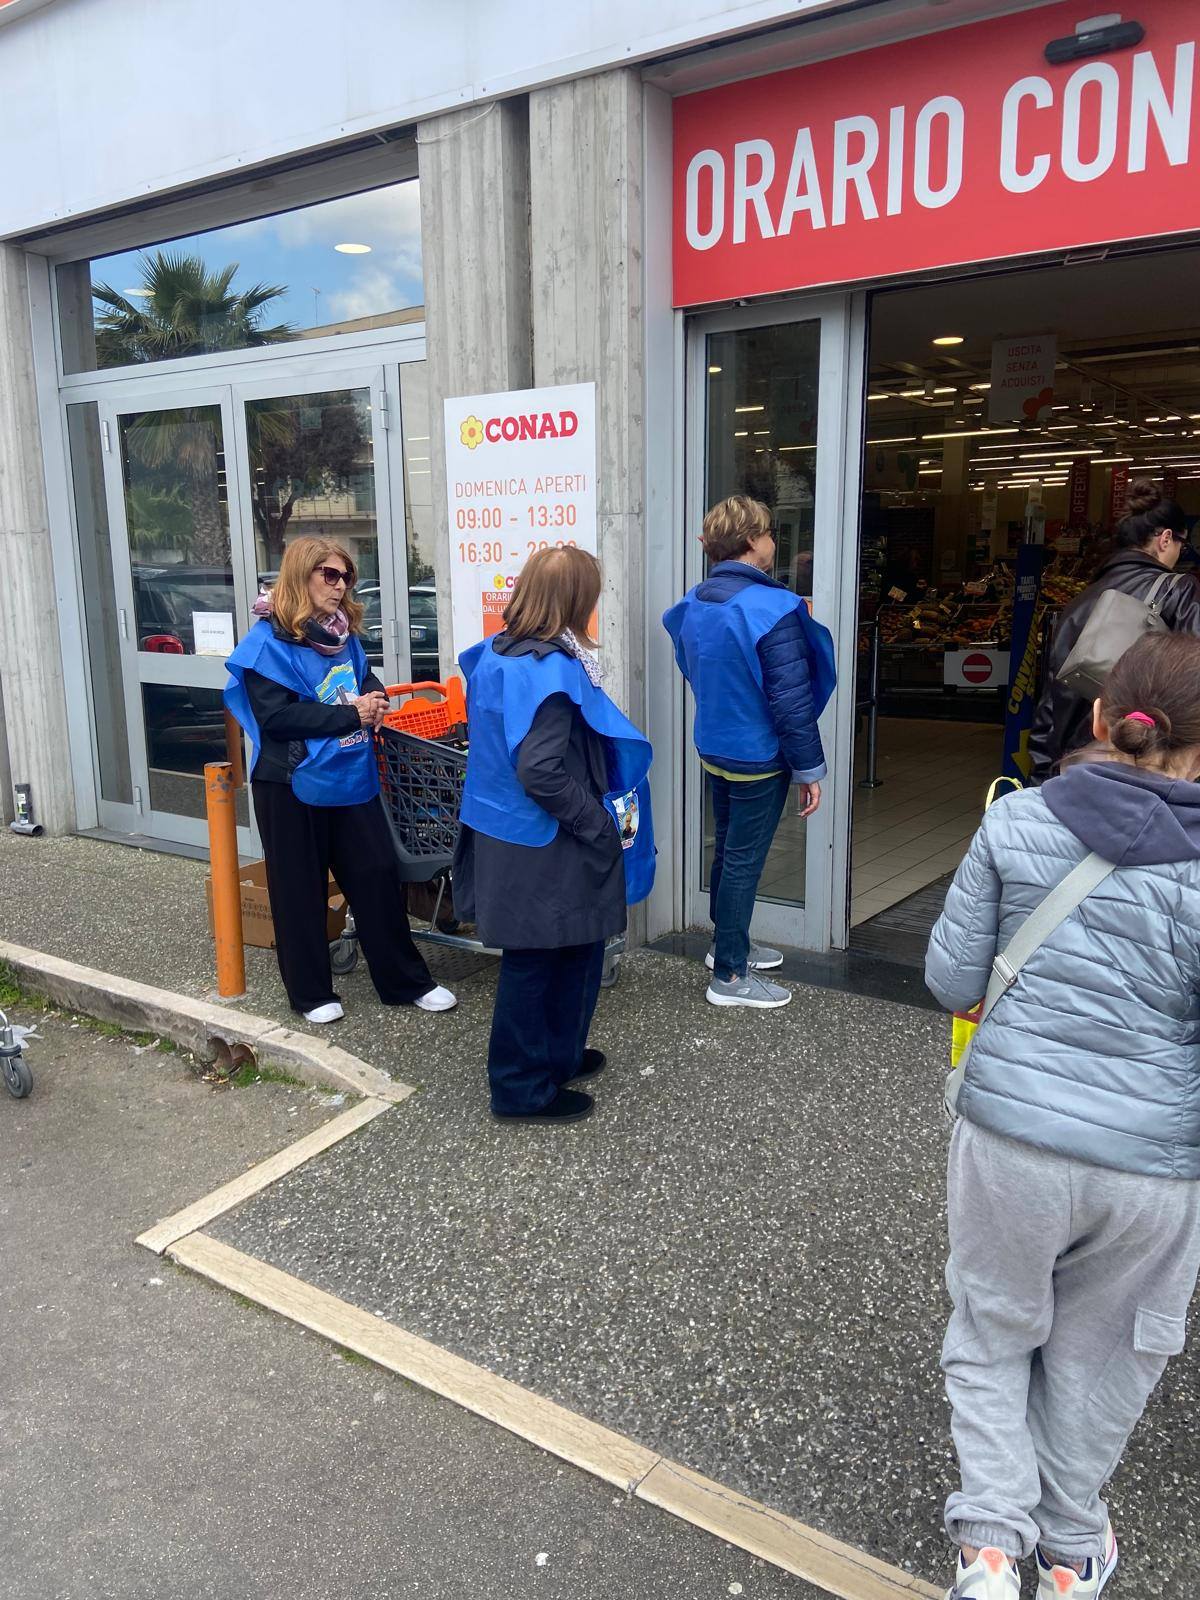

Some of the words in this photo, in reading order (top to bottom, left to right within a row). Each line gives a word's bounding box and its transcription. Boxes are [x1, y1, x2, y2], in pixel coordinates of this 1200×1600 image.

[686, 95, 965, 251] ORARIO
[1000, 41, 1195, 193] CON
[1008, 344, 1042, 357] USCITA
[1006, 361, 1039, 373] SENZA
[1001, 375, 1045, 388] ACQUISTI
[485, 411, 578, 442] CONAD
[455, 478, 527, 498] DOMENICA
[534, 475, 586, 494] APERTI
[1072, 461, 1088, 513] OFFERTA
[456, 507, 502, 530] 09:00
[527, 504, 577, 528] 13:30
[459, 542, 502, 563] 16:30
[483, 604, 495, 613] DAL
